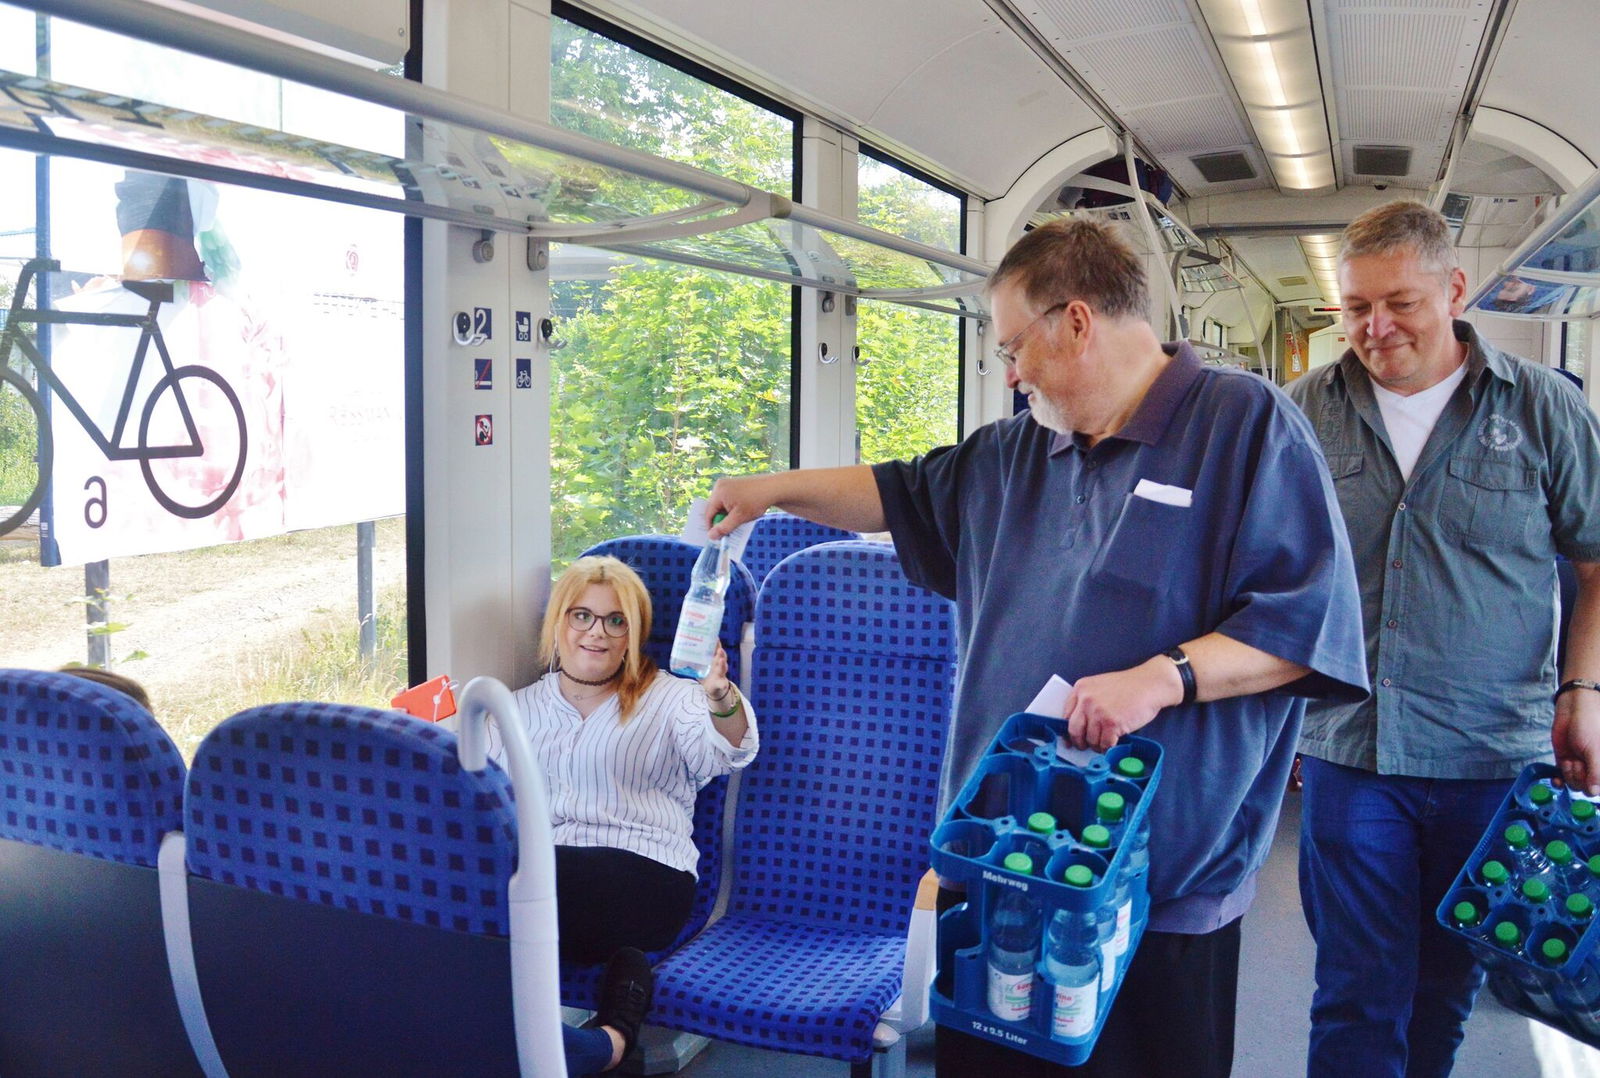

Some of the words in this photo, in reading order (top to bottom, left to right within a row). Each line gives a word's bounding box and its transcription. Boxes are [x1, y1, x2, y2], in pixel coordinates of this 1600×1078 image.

[475, 309, 487, 338] 2
[983, 870, 1028, 891] Mehrweg
[972, 1021, 982, 1031] 12
[1006, 1032, 1028, 1045] Liter
